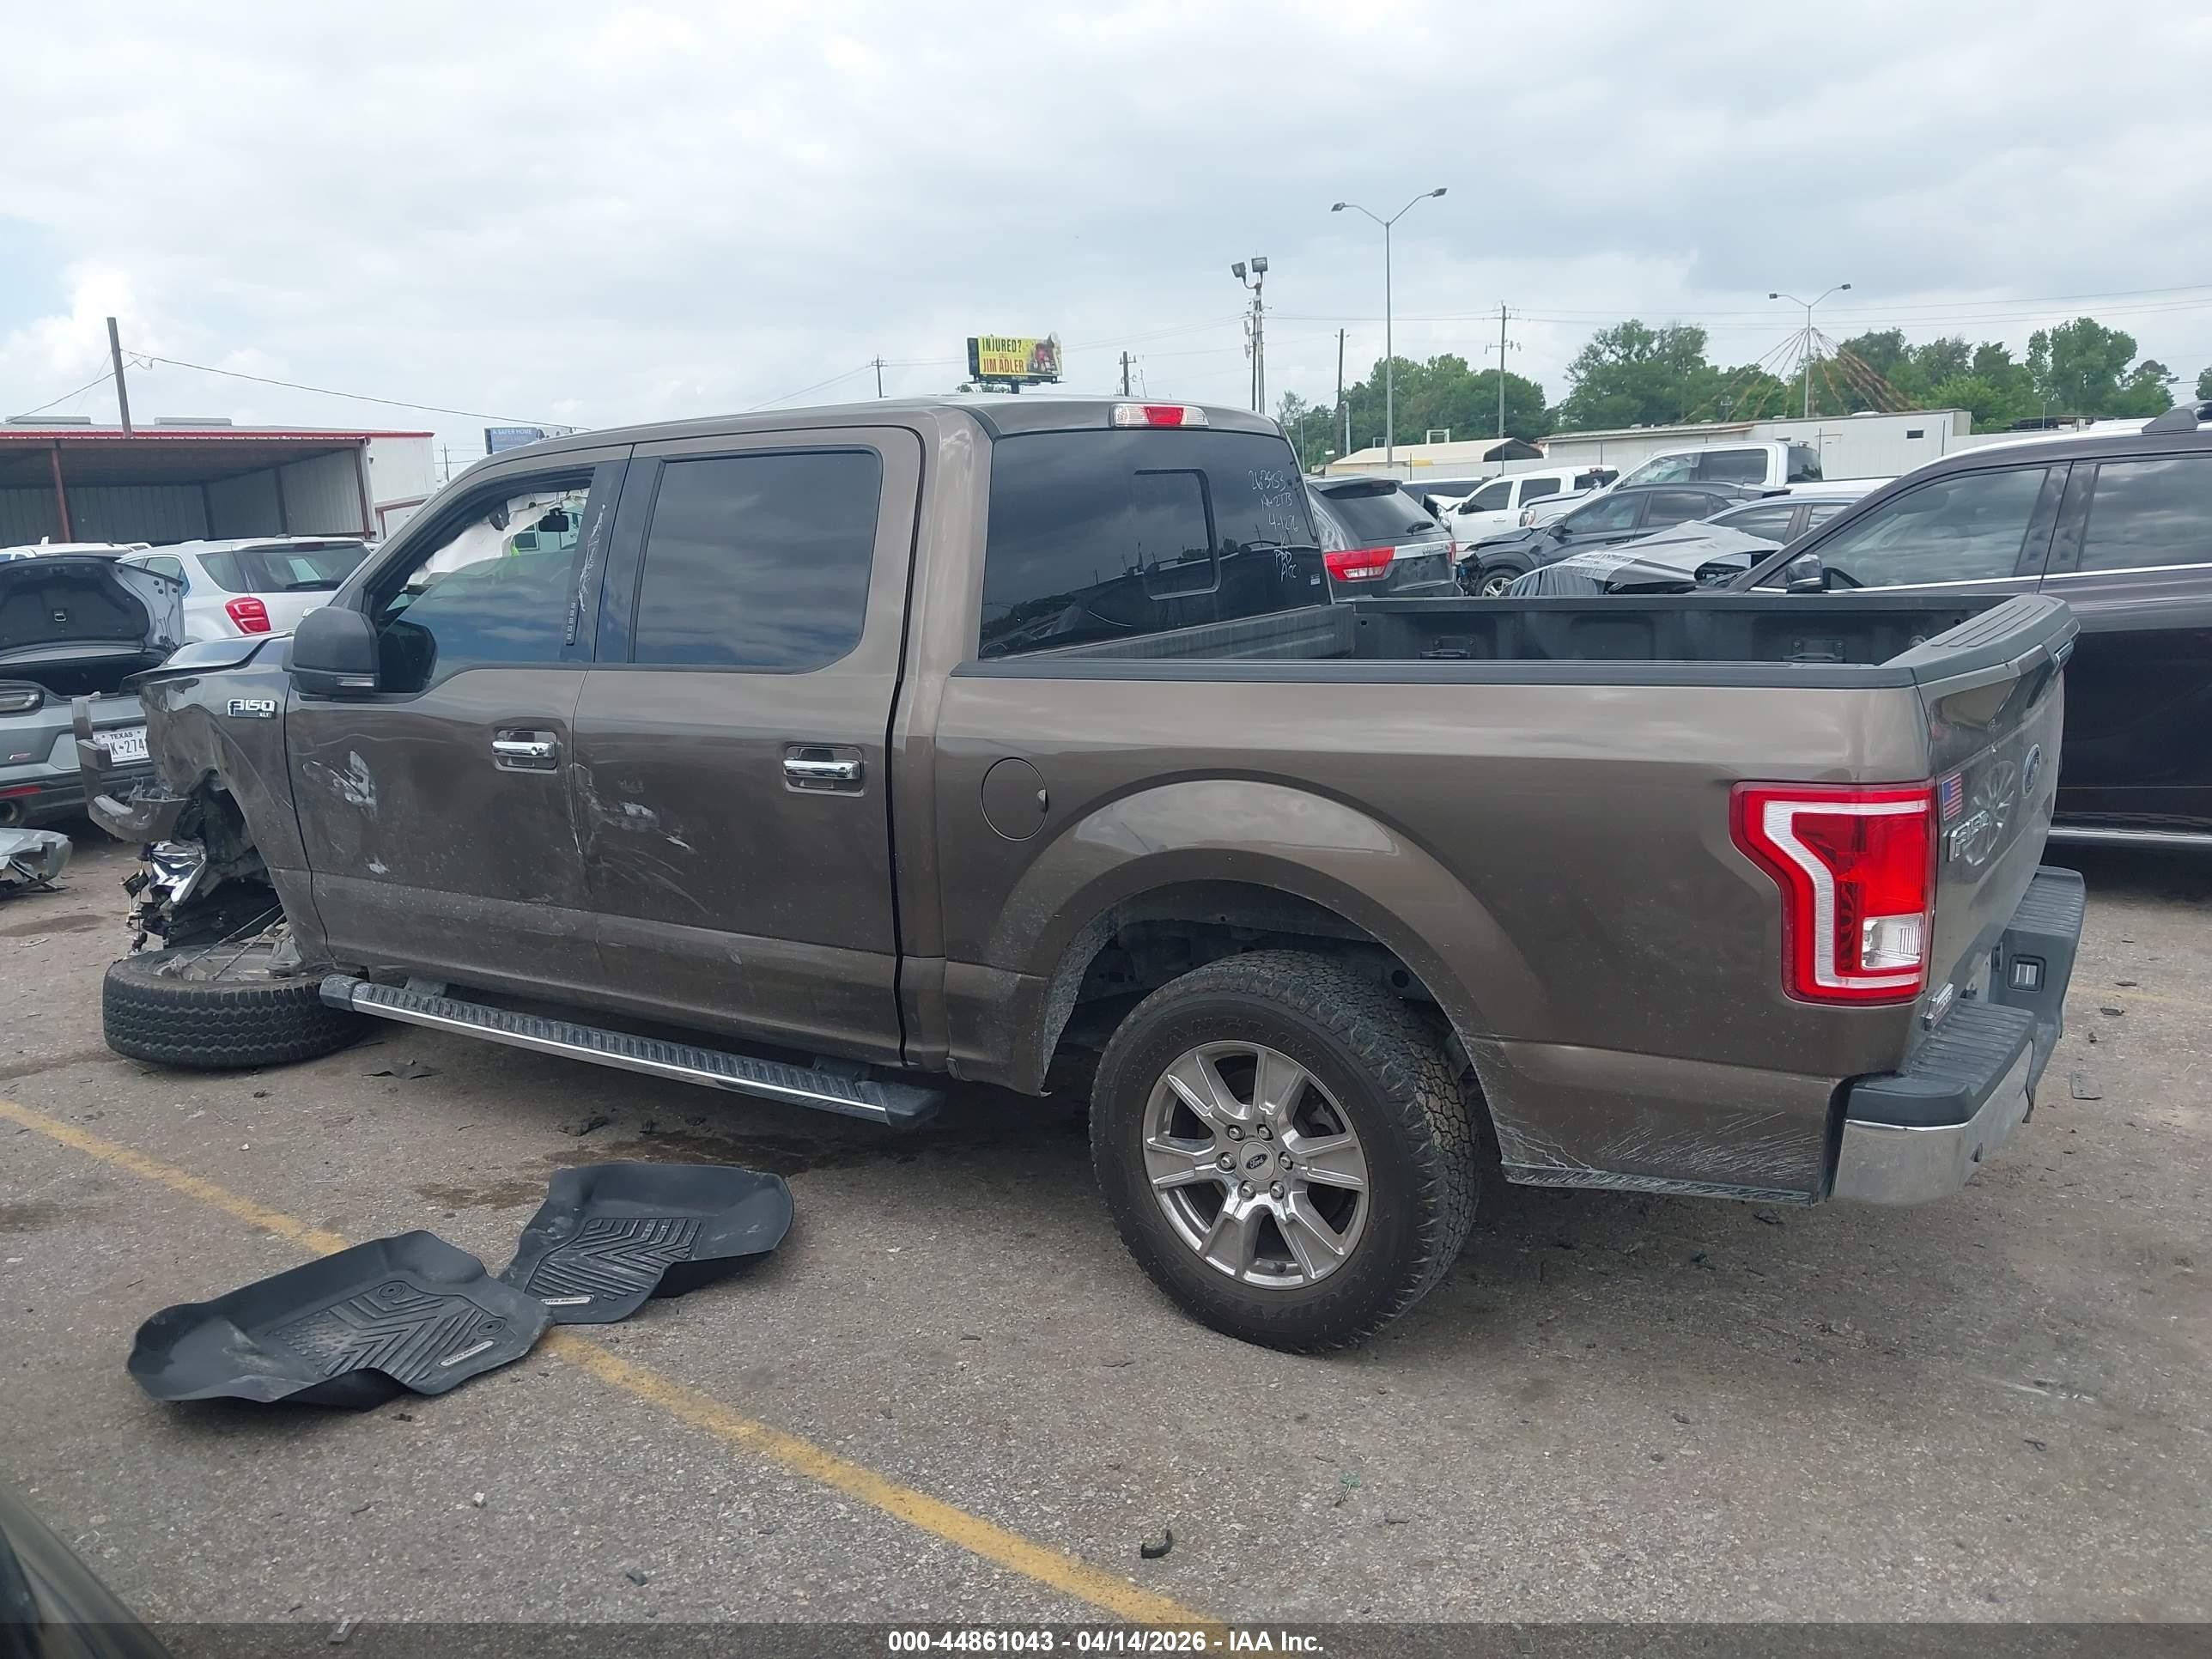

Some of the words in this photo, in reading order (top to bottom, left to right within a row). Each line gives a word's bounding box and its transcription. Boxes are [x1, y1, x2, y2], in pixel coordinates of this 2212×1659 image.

[981, 337, 1022, 353] INJURED?
[983, 357, 996, 373] JIM
[999, 358, 1024, 374] ADLER
[110, 731, 134, 740] TEXAS
[1249, 1156, 1265, 1169] Ford
